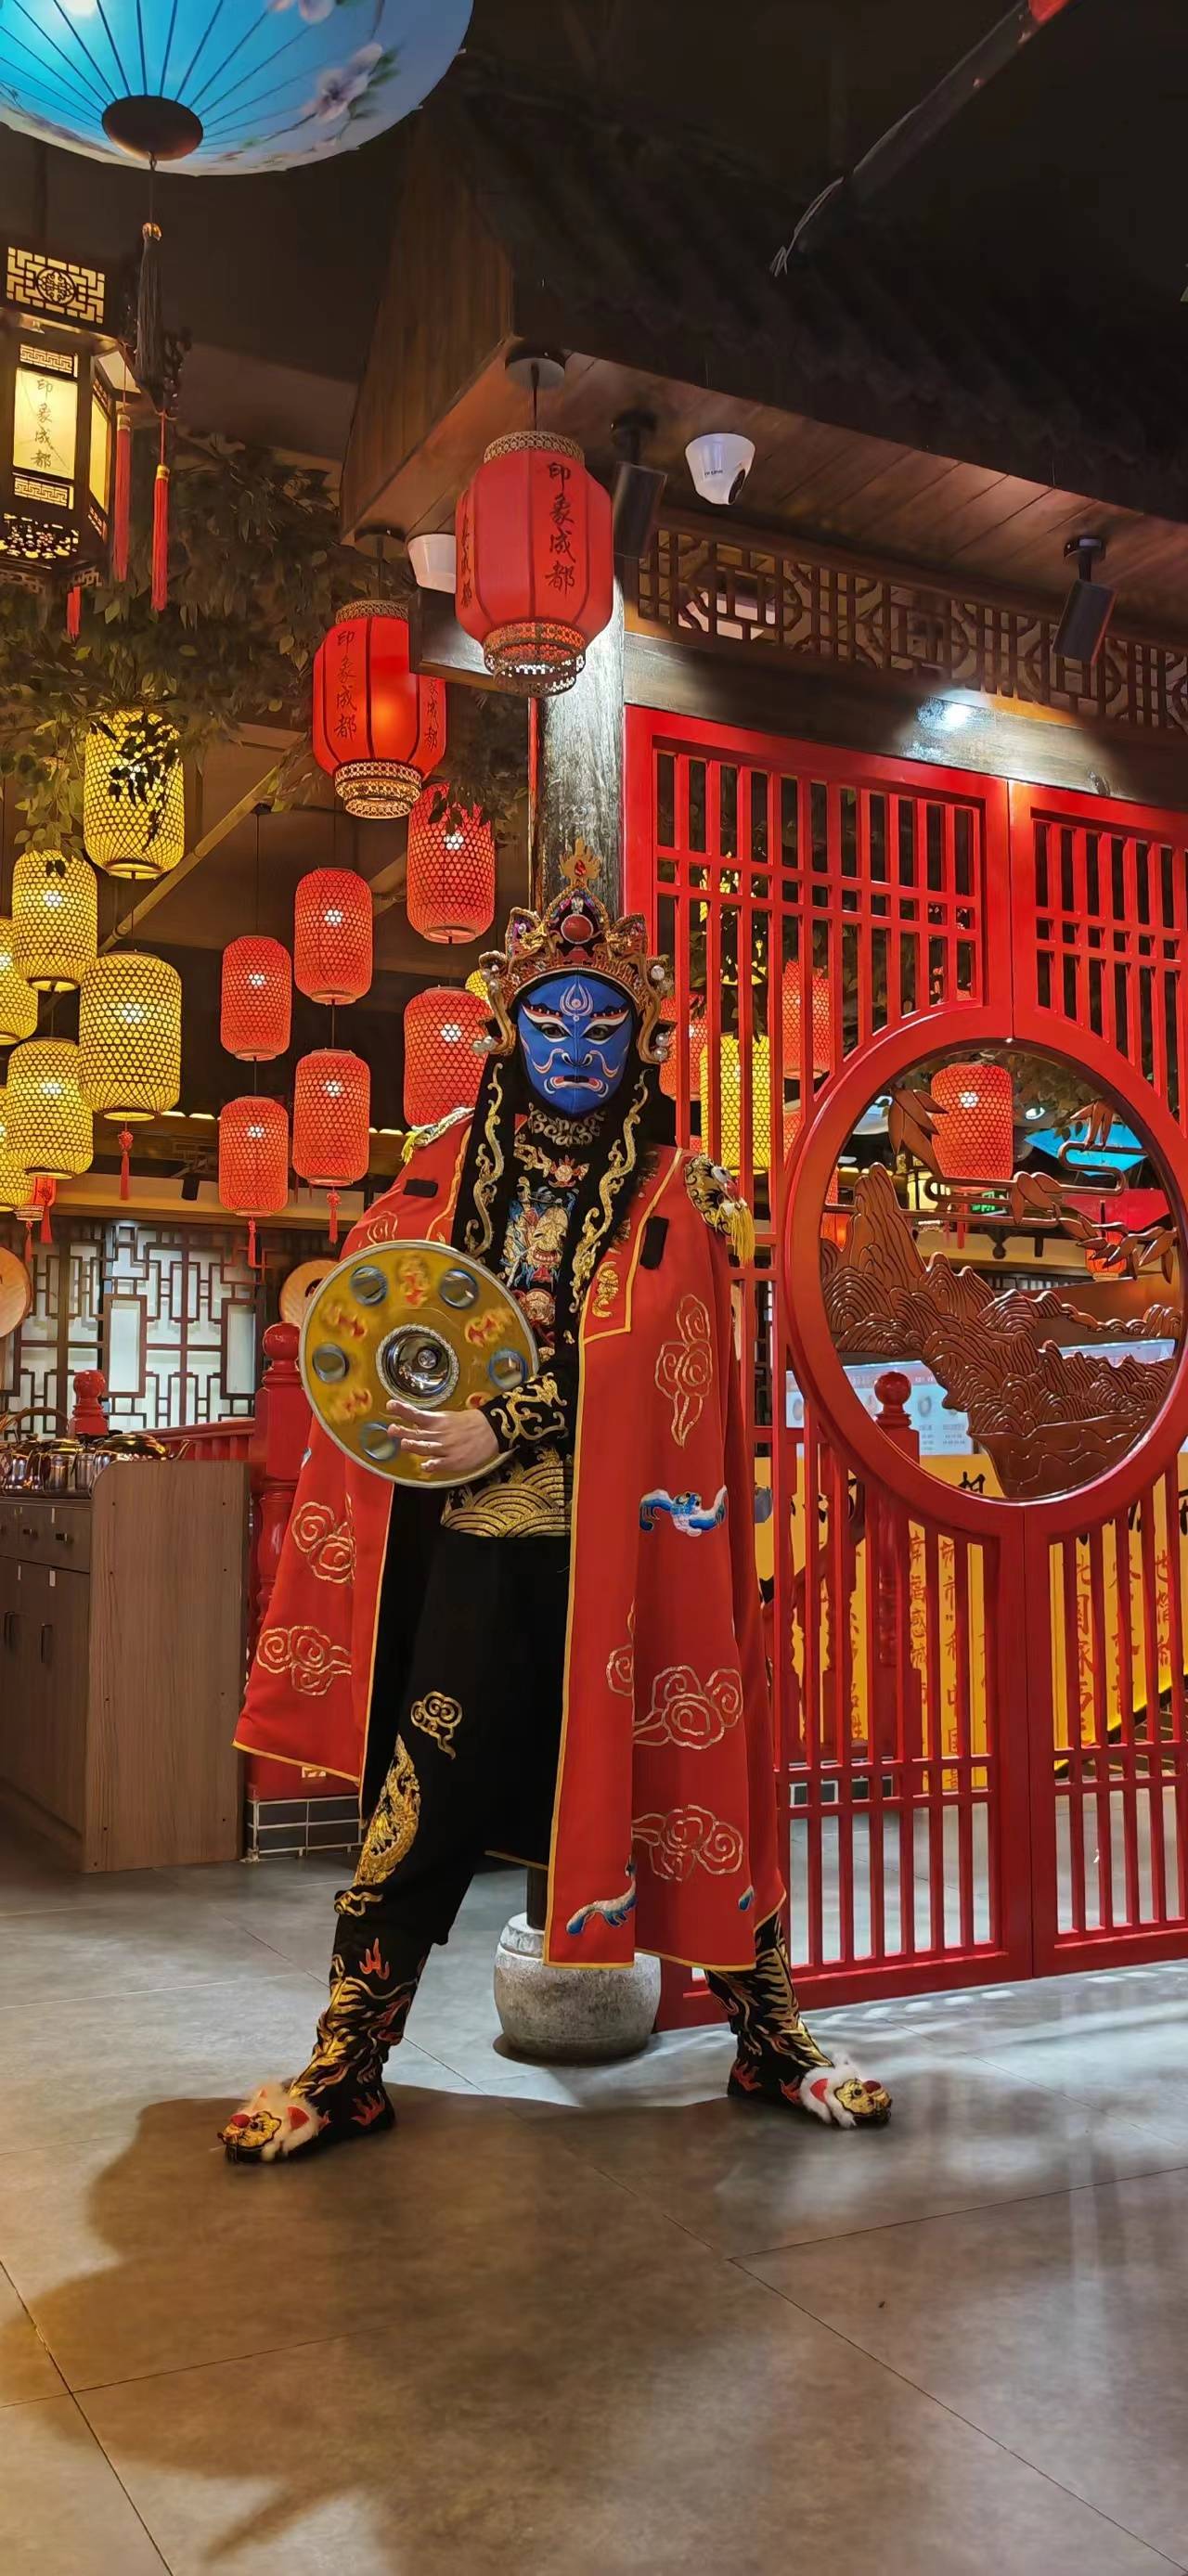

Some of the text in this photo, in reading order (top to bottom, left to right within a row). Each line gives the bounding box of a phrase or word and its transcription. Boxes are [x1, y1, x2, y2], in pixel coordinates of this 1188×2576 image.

[31, 379, 54, 468] 印象成都
[546, 462, 576, 599] 印象成都
[334, 630, 357, 741] 印象成都
